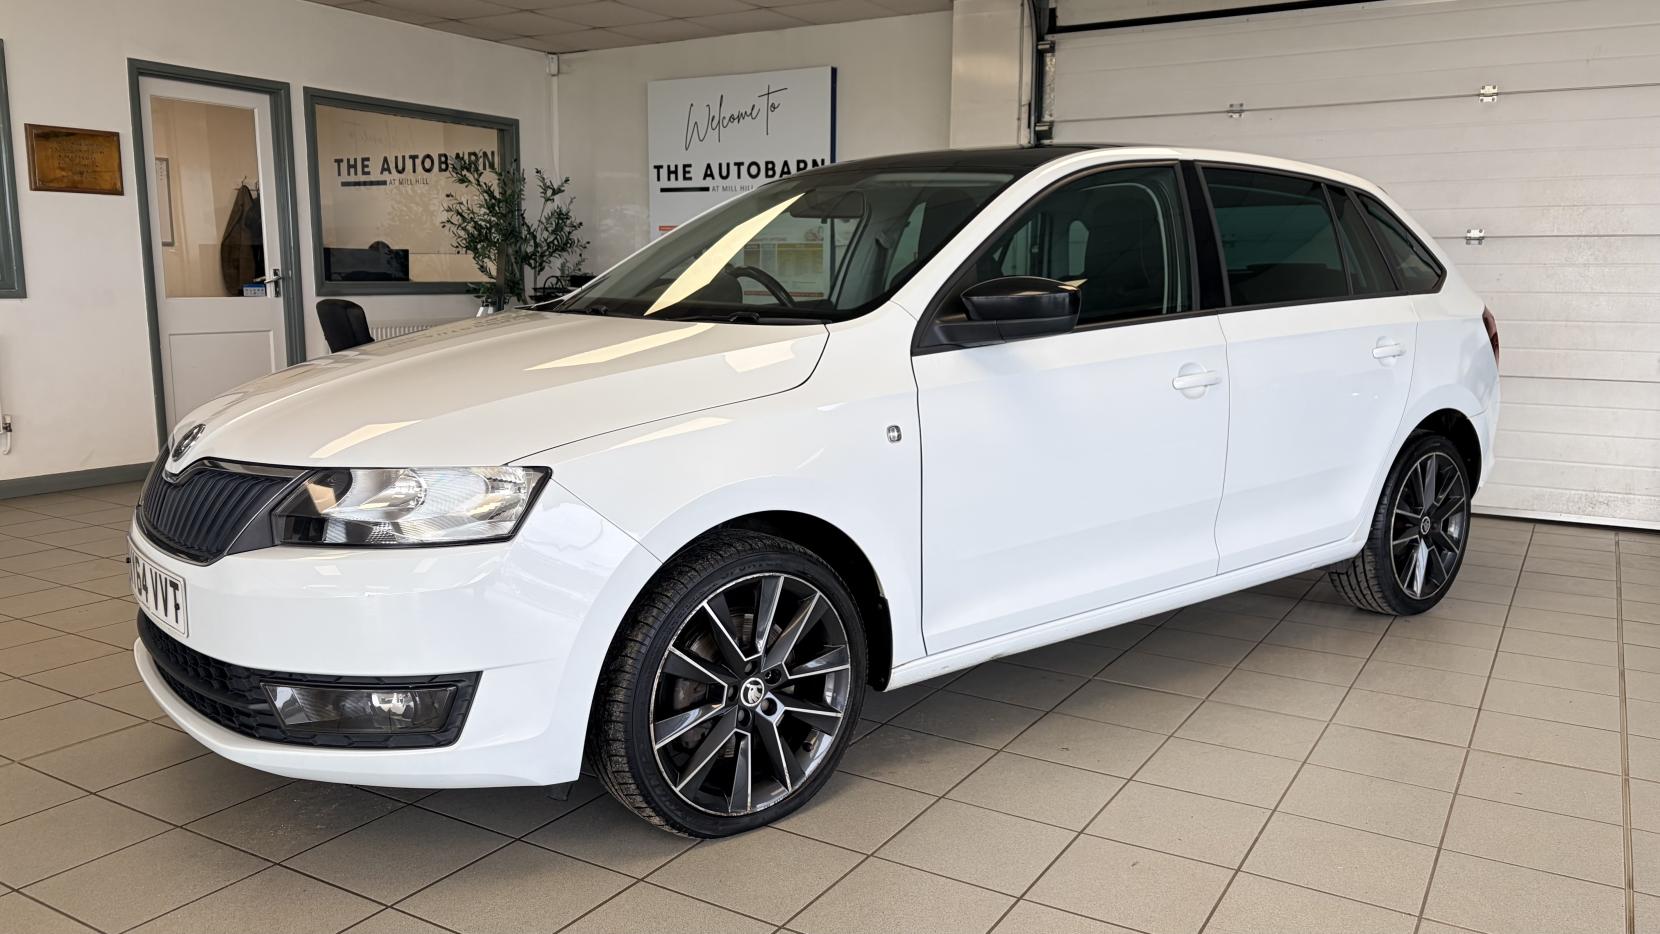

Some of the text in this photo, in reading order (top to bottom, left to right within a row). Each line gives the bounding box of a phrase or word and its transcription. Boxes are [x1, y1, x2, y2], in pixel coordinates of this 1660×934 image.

[685, 84, 788, 151] Welcome to
[333, 157, 371, 176] THE
[653, 163, 693, 182] THE
[398, 177, 414, 186] MILL
[415, 177, 429, 185] HILL
[150, 567, 180, 624] VVT
